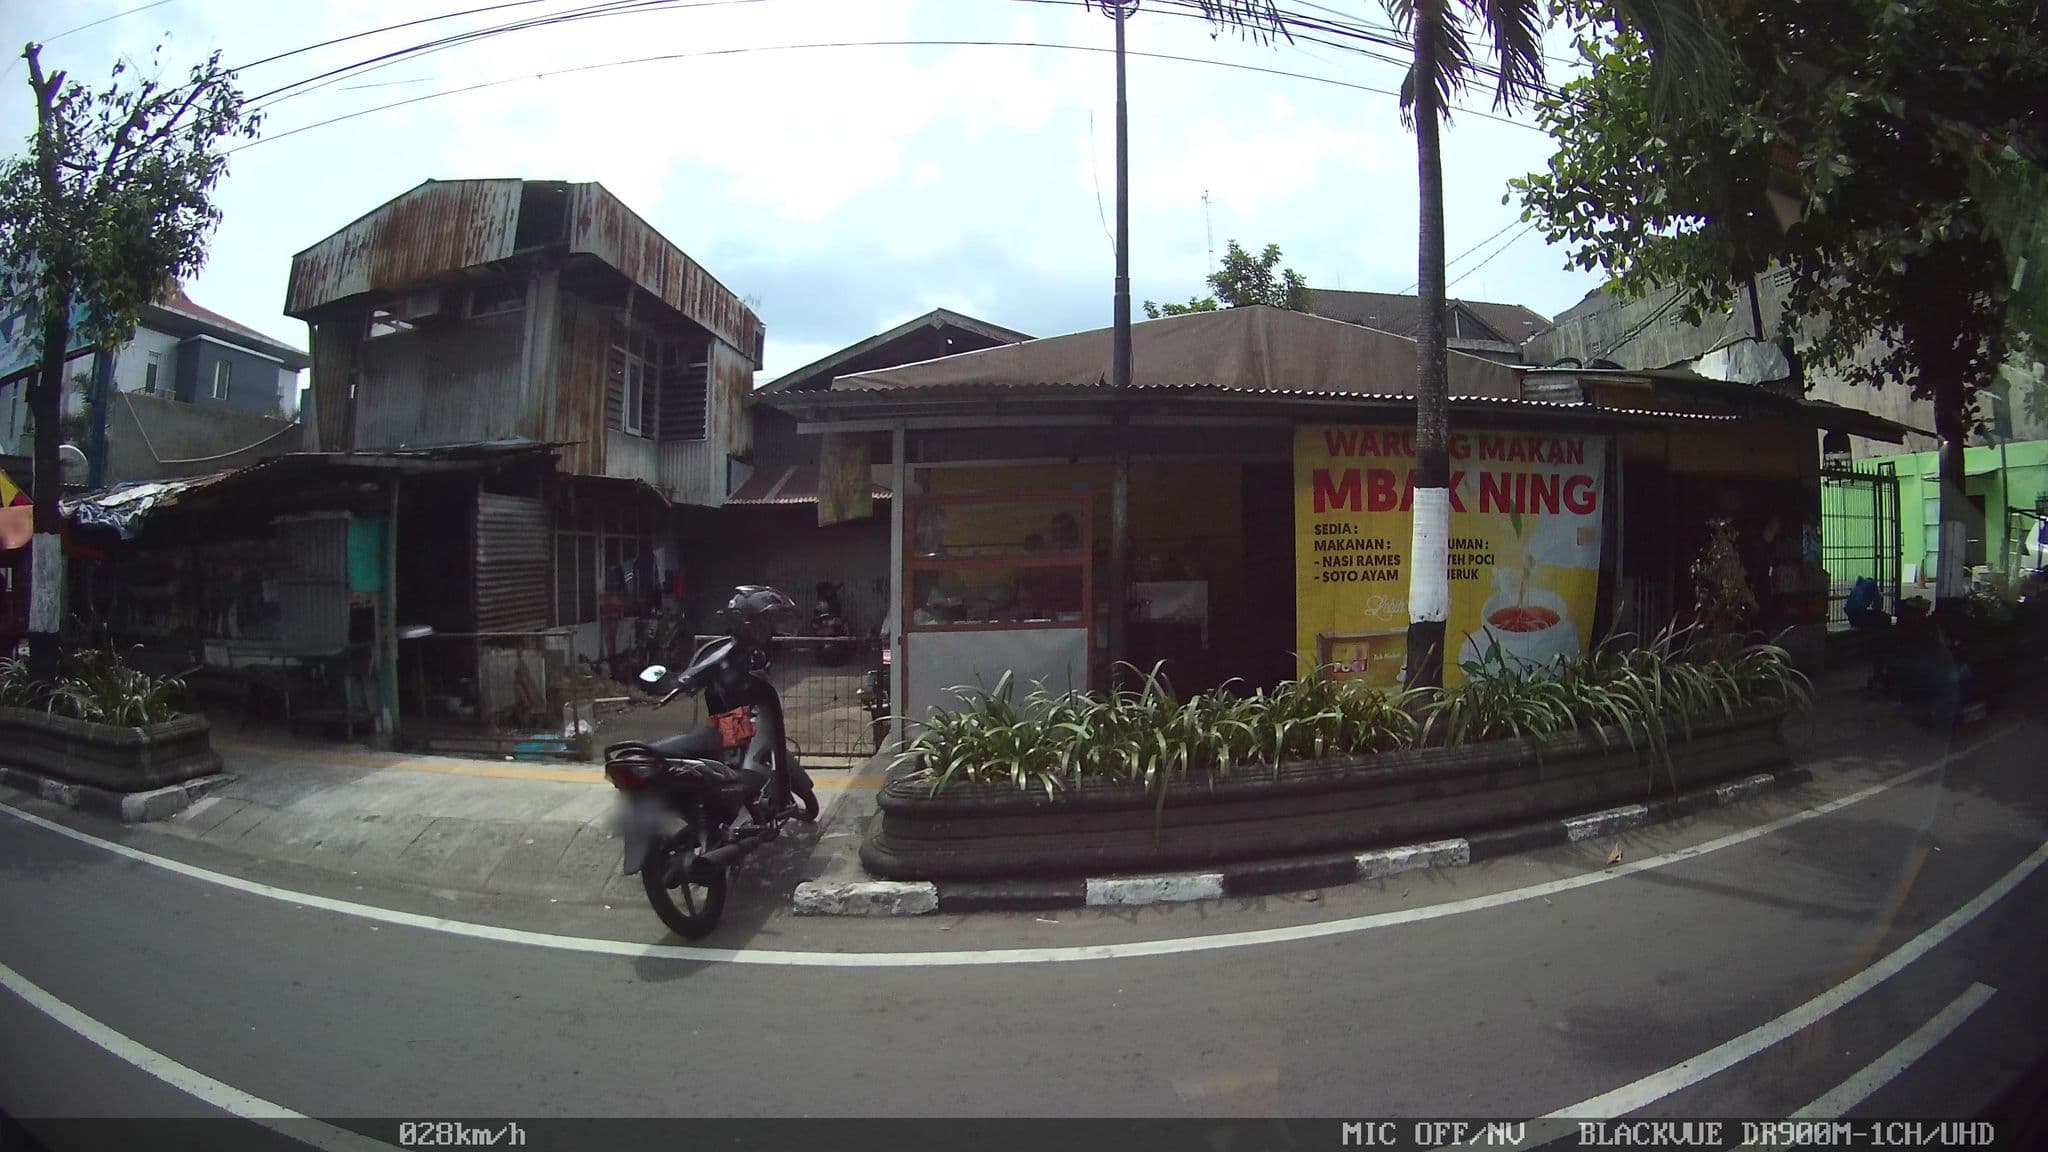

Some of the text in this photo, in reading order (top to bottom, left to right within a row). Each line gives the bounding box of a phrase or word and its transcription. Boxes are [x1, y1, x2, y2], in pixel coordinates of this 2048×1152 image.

[1322, 431, 1584, 465] WARUG MAKAN
[1479, 472, 1597, 515] NING
[1314, 523, 1352, 536] SEDIA
[1314, 538, 1385, 552] MAKANAN
[1447, 538, 1483, 550] UMAN
[1322, 554, 1354, 568] NASI
[1356, 554, 1401, 567] RAMES
[1468, 553, 1495, 566] POCI
[1322, 570, 1359, 582] SOTO
[1360, 569, 1399, 582] AYAM
